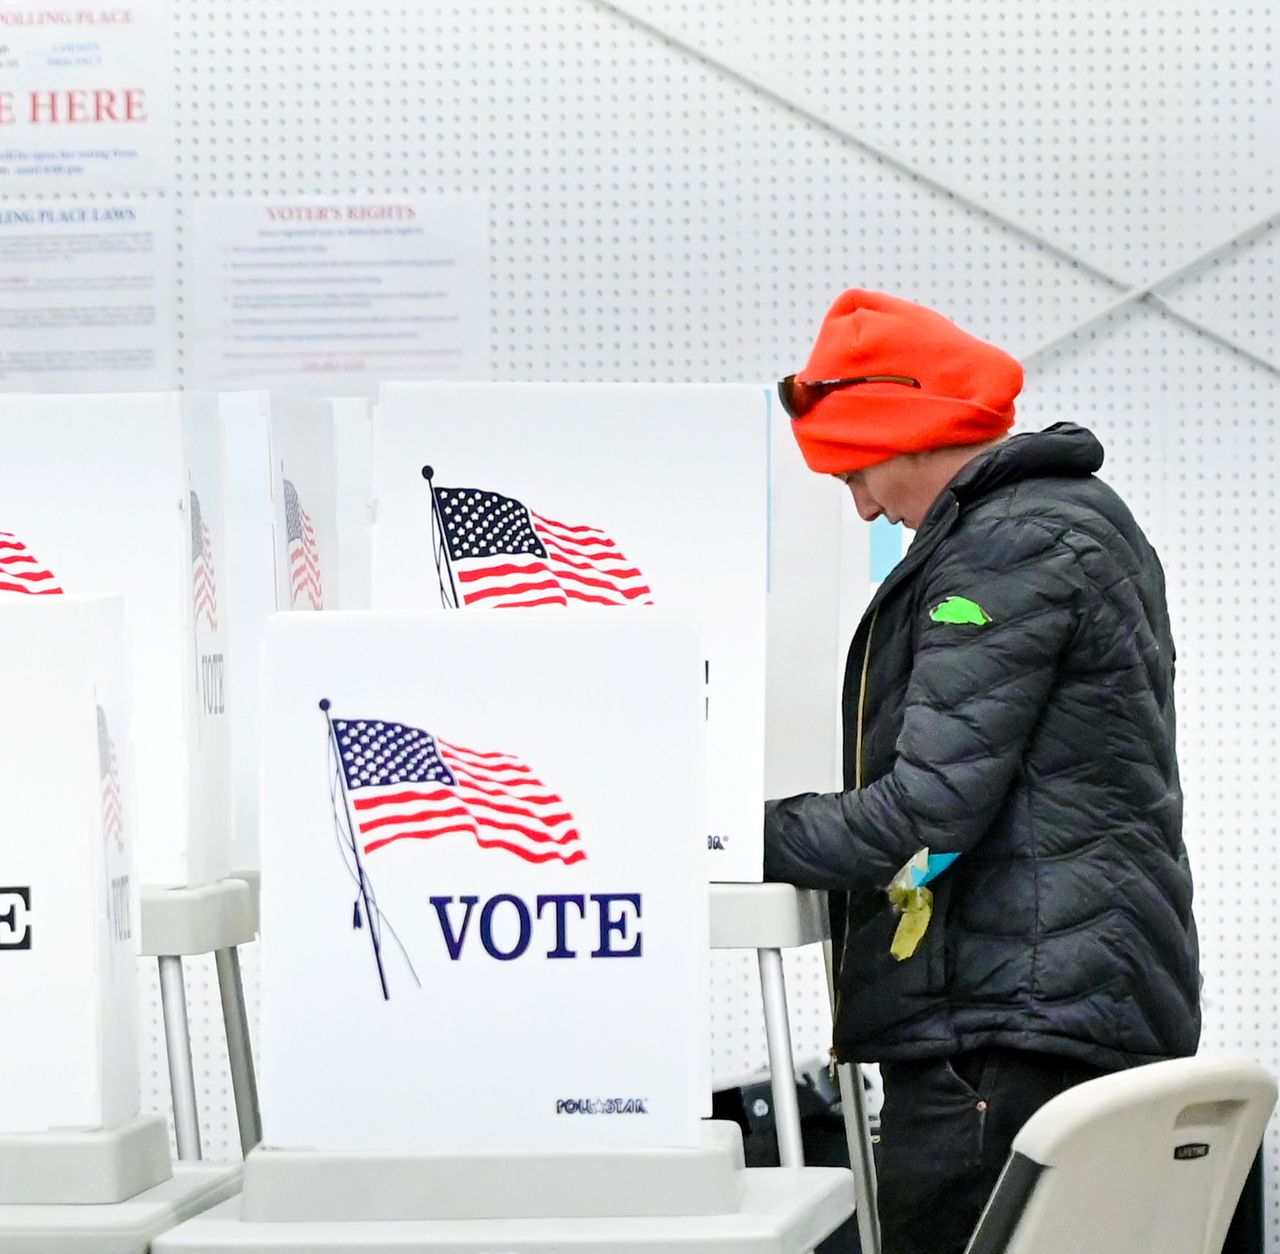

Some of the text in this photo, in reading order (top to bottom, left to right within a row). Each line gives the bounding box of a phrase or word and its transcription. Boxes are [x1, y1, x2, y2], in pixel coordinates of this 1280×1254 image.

[76, 9, 134, 25] PLACE
[29, 88, 149, 124] HERE
[39, 209, 87, 223] PLACE
[93, 207, 136, 221] LAWS
[266, 204, 416, 222] VOTER'S RIGHTS
[429, 893, 643, 961] VOTE
